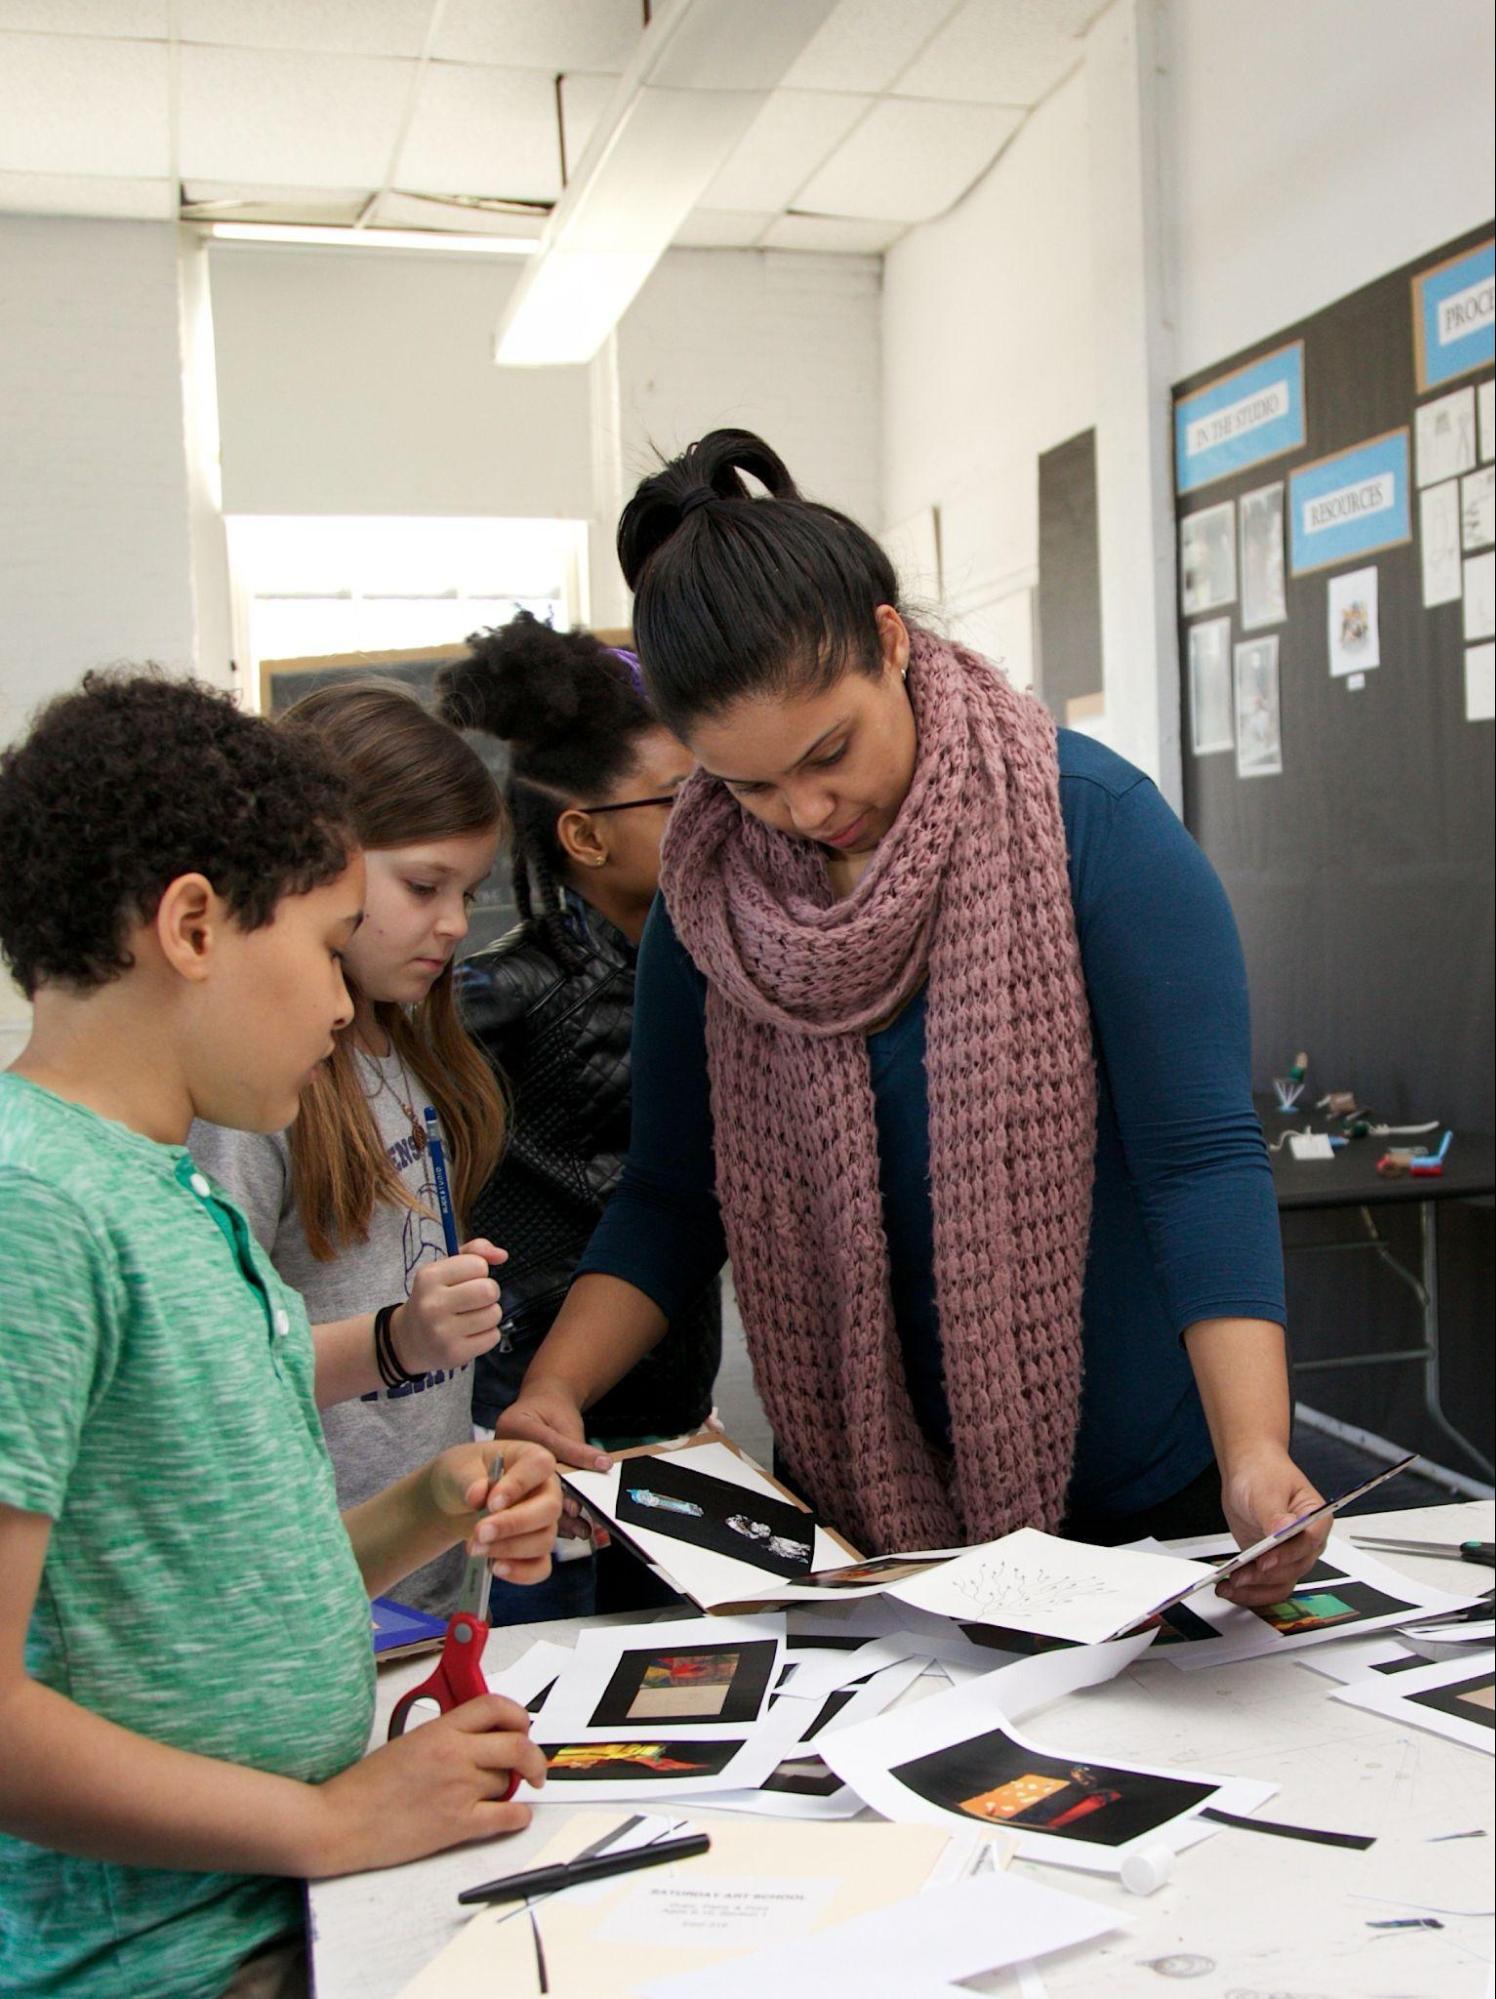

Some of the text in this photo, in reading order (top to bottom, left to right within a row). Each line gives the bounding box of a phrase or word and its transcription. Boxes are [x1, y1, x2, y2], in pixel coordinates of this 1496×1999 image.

[1195, 391, 1280, 450] IN THE STUDIO
[1311, 480, 1384, 528] RESOURCES
[651, 1888, 806, 1901] SATURDAY ART SCHOOL
